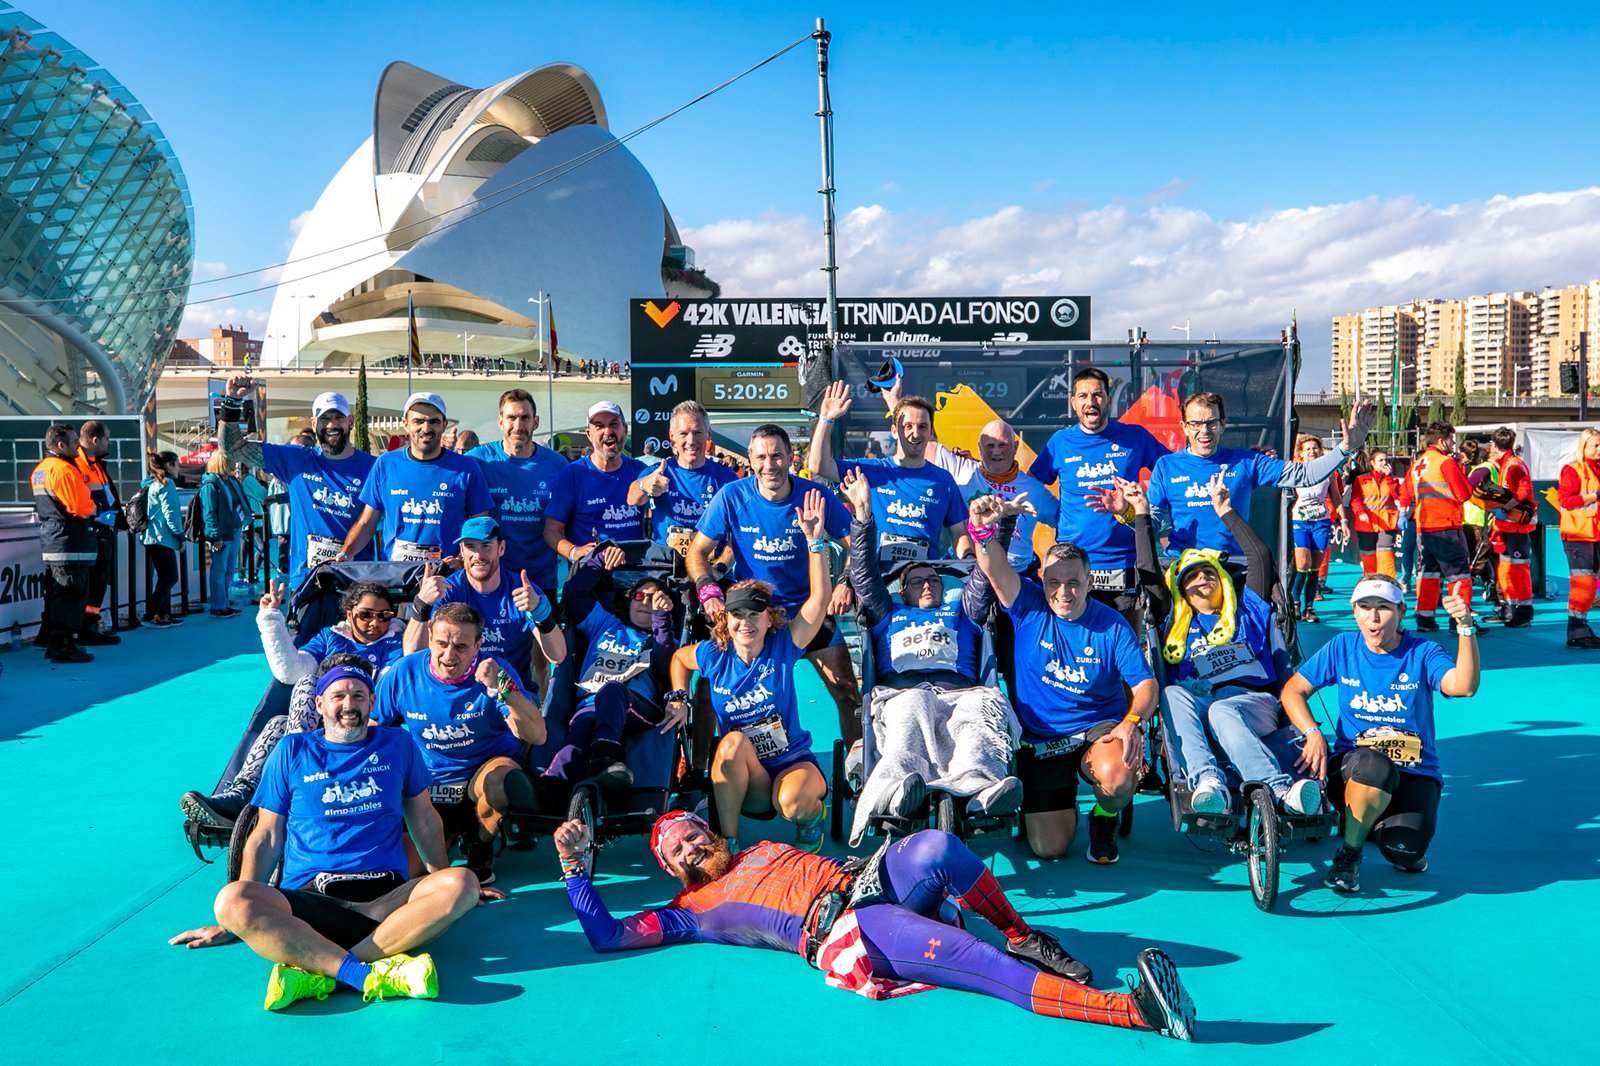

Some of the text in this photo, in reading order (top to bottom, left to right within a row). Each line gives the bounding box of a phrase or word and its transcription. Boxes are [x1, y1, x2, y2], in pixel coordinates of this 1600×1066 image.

[683, 301, 1040, 326] 42K VALENCIA TRINIDAD ALFONSO
[714, 383, 788, 400] 5:20:26
[891, 546, 918, 558] 28216
[902, 627, 951, 649] aefat
[915, 648, 935, 660] JON
[1211, 654, 1239, 670] ALEX
[1390, 682, 1418, 691] ZURICH
[362, 763, 391, 774] ZURICH
[324, 800, 382, 816] #Imparables
